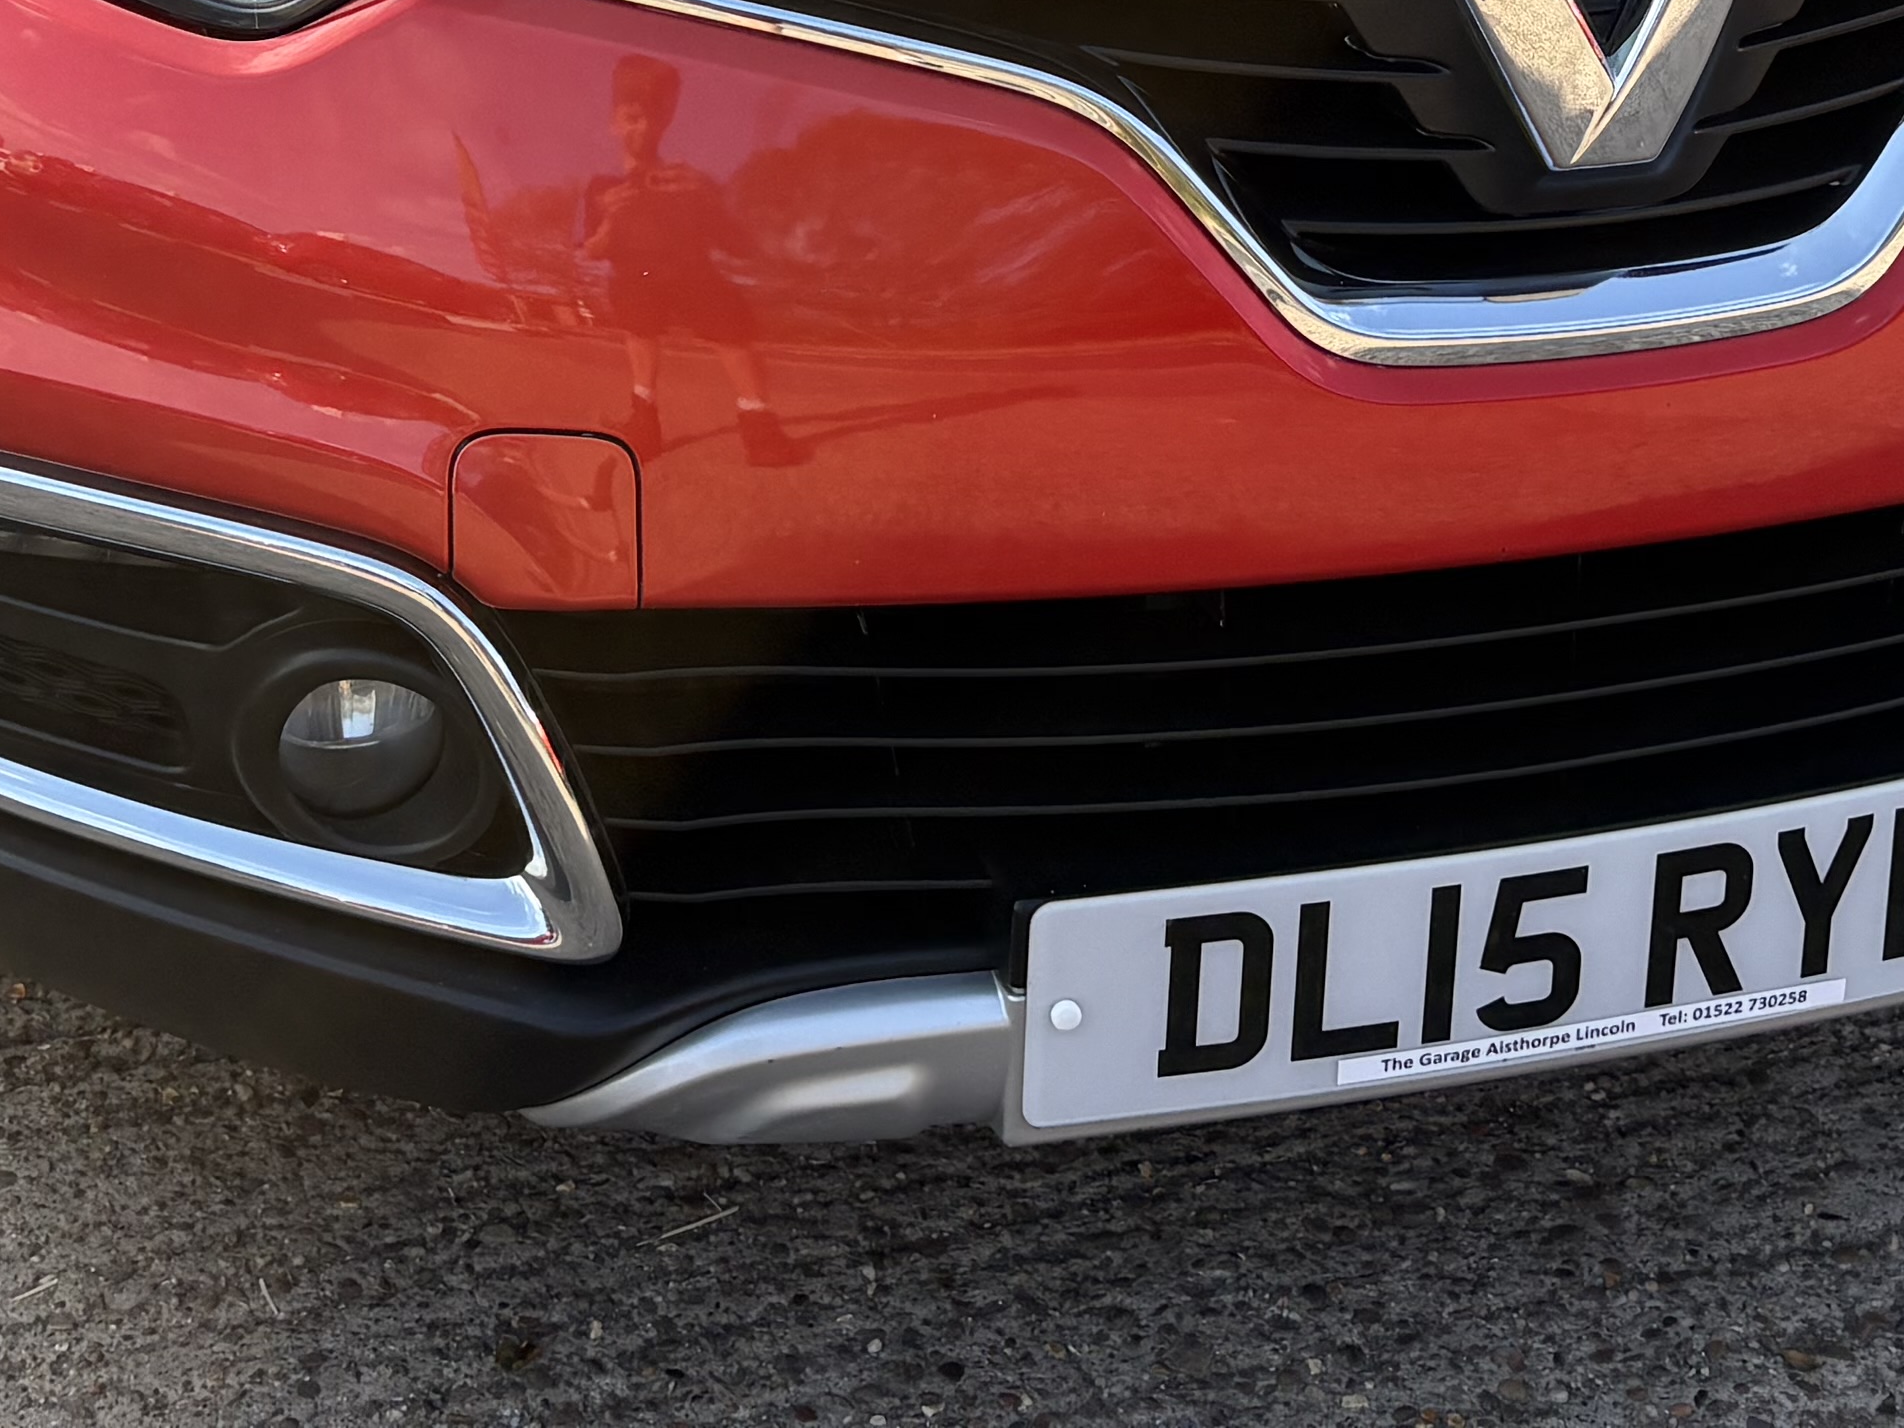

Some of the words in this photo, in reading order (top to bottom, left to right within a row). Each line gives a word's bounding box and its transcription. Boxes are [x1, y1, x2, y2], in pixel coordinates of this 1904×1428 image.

[1157, 864, 1590, 1078] DL15
[1381, 1057, 1414, 1074] The
[1419, 1046, 1482, 1069] Garage
[1486, 1029, 1572, 1056] Aisthorpe
[1576, 1020, 1637, 1042] Lincoln
[1659, 1010, 1689, 1028] Tel:
[1692, 1000, 1744, 1022] 01522
[1748, 990, 1809, 1014] 730258
